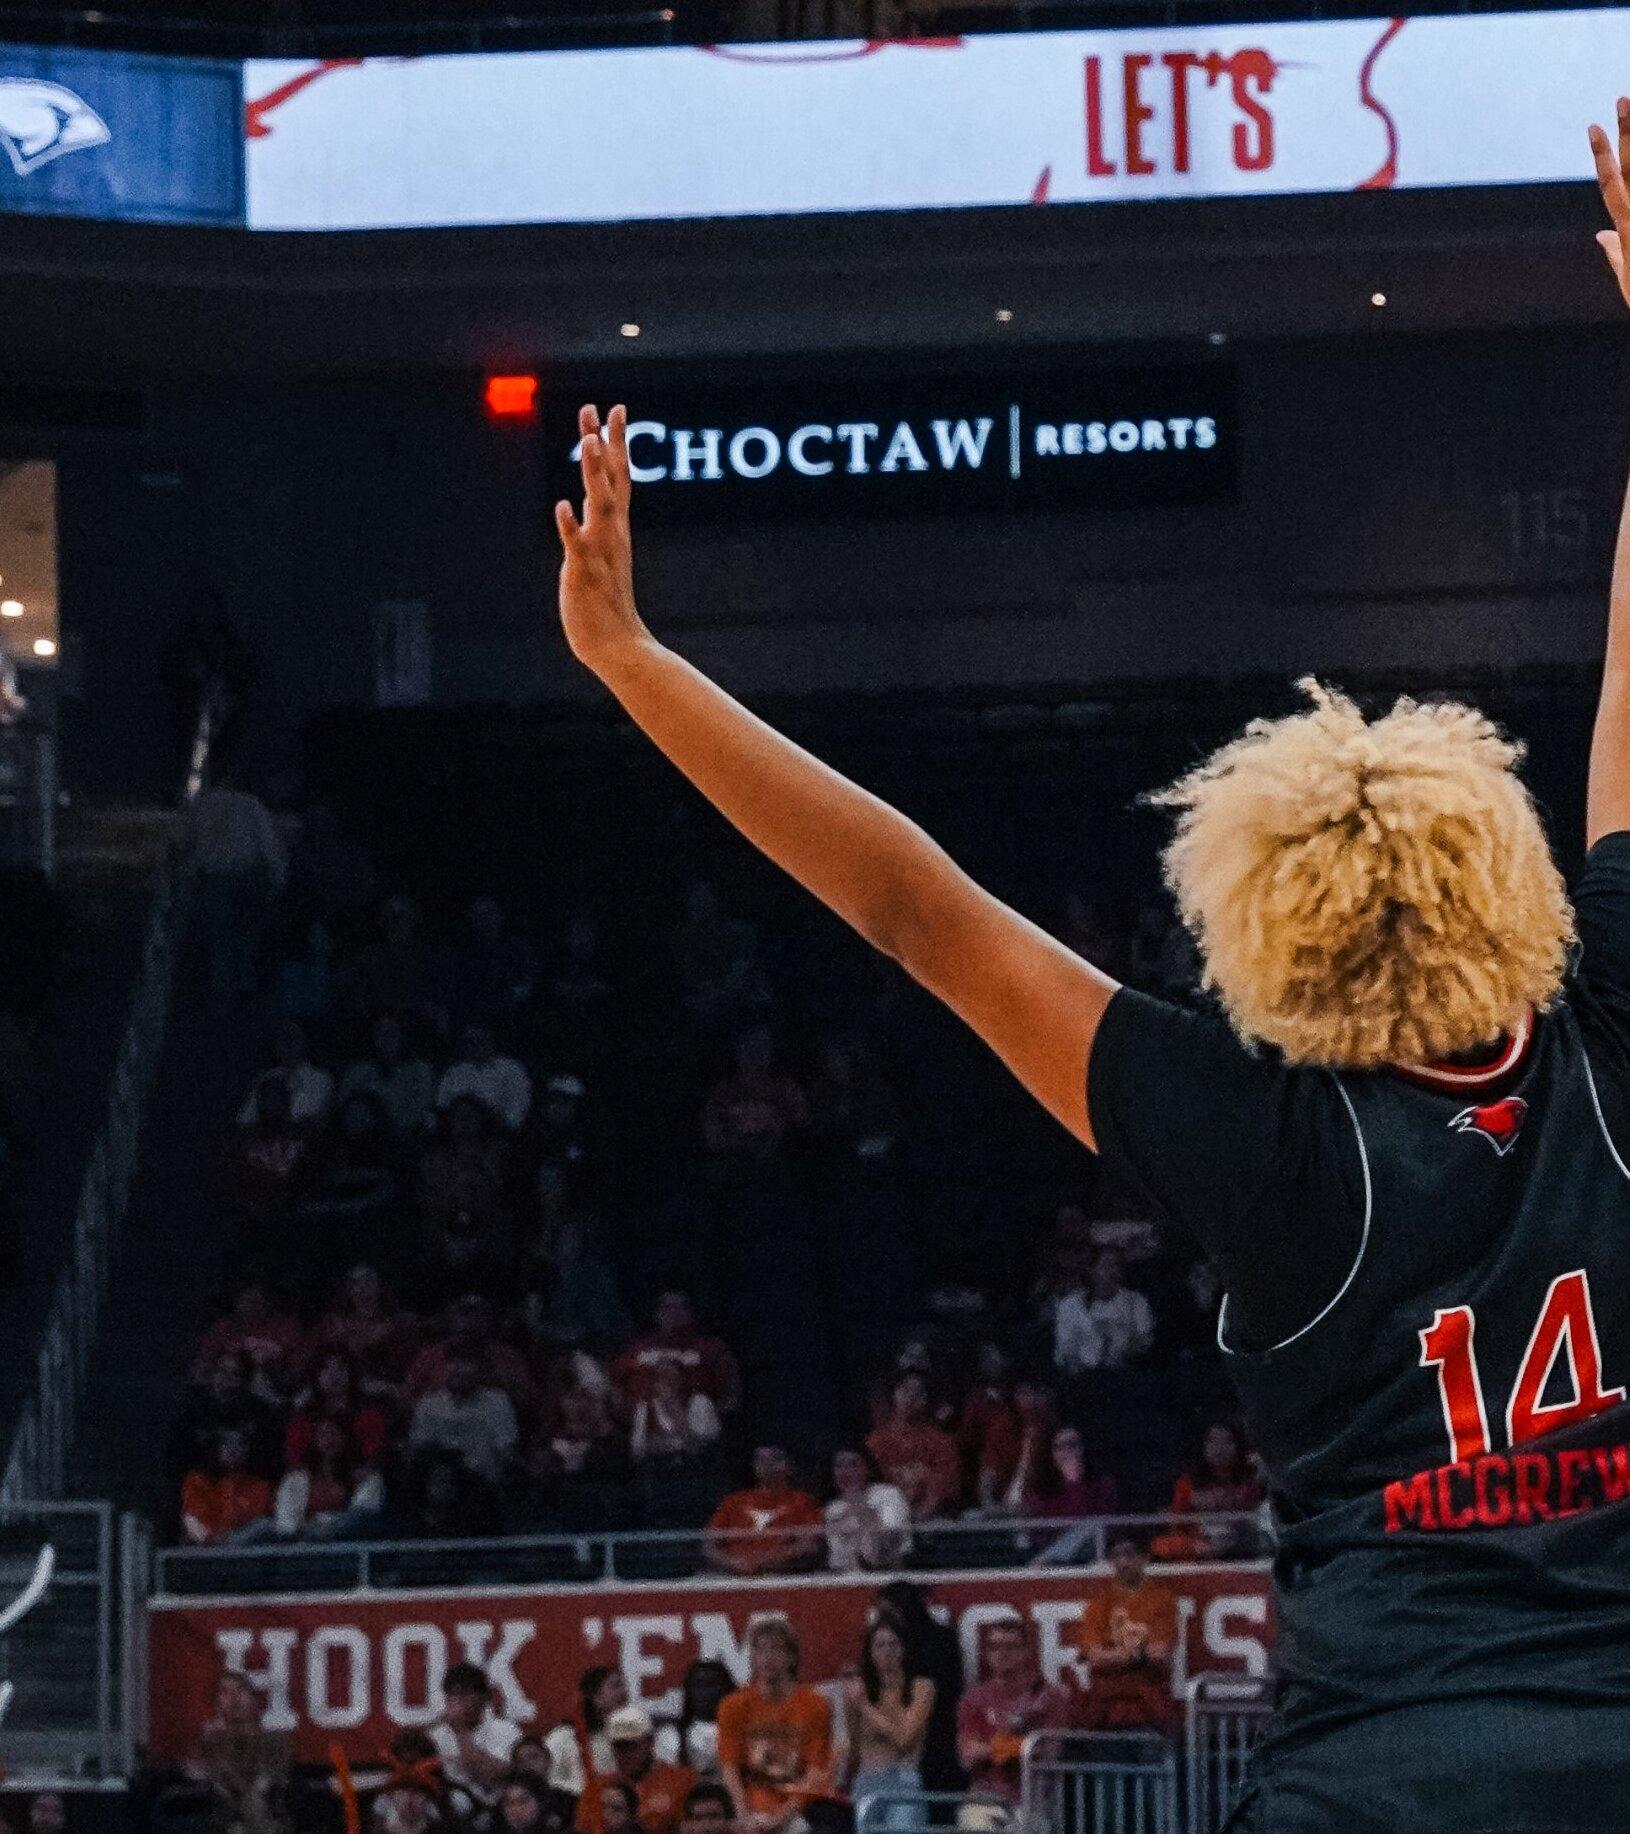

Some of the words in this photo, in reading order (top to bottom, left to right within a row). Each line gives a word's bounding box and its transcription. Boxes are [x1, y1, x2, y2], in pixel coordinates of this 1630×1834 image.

[1085, 48, 1276, 176] LET'S
[626, 416, 993, 482] CHOCTAW
[1036, 418, 1216, 456] RESORTS
[1419, 1268, 1627, 1464] 14
[215, 1618, 537, 1733] HOOK
